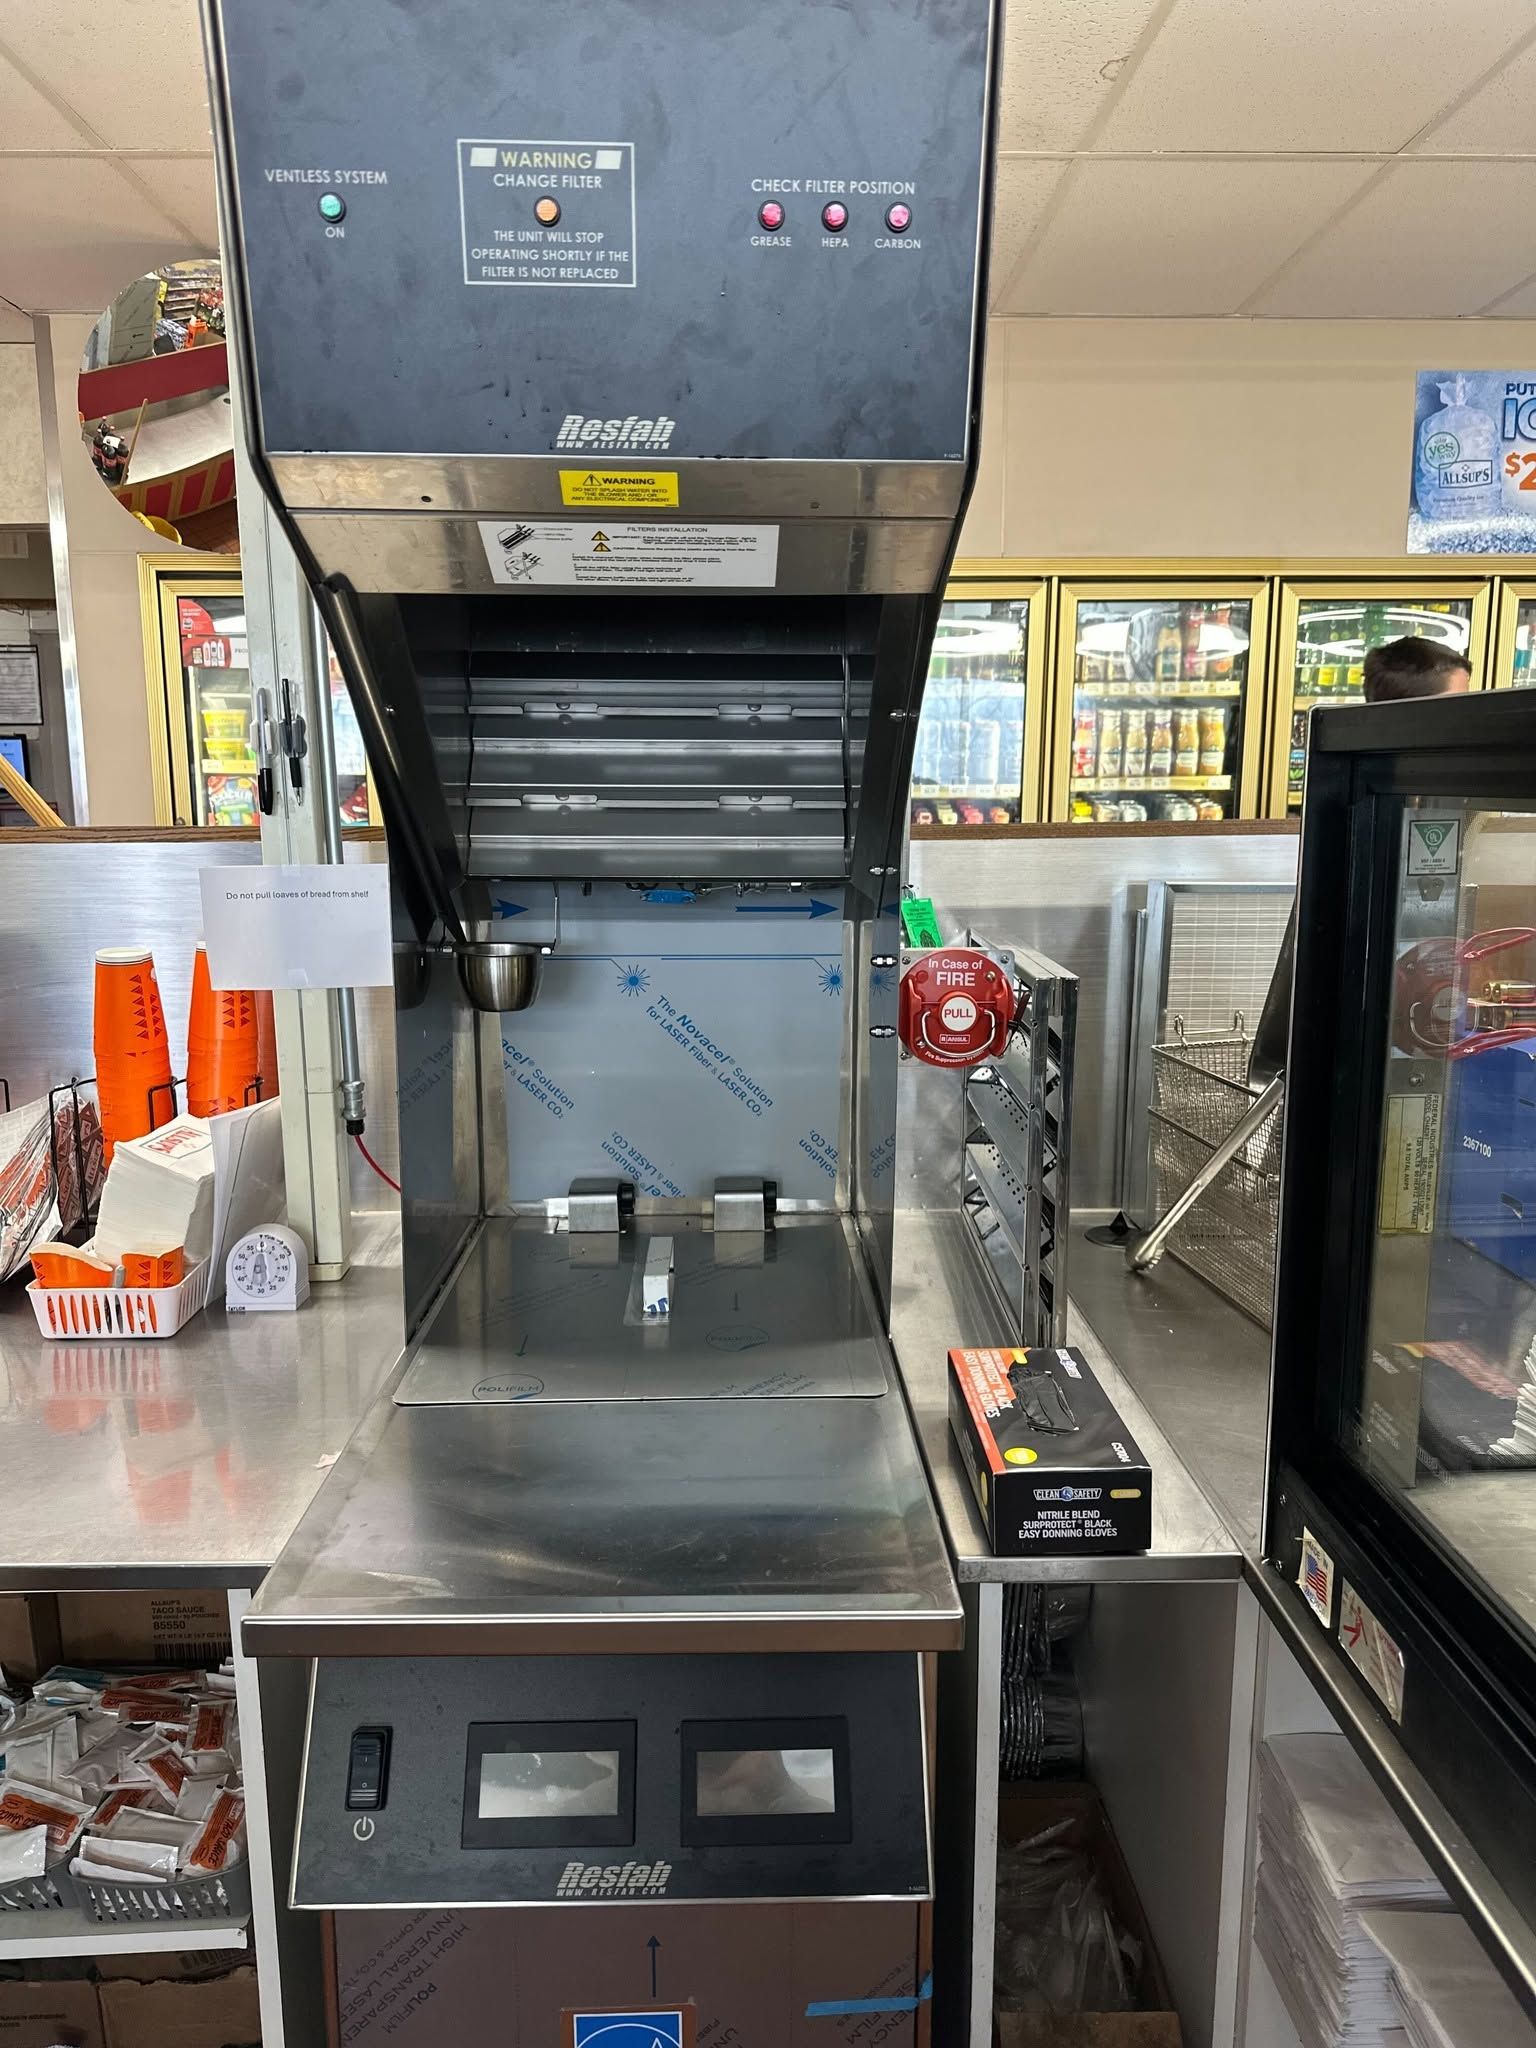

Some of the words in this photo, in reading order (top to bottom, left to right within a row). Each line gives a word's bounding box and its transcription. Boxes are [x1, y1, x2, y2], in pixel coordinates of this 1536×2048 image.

[500, 151, 592, 169] WARNING
[264, 169, 331, 184] VENTLESS
[335, 170, 388, 185] SYSTEM
[493, 173, 557, 188] CHANGE
[562, 174, 602, 189] FILTER
[751, 179, 801, 193] CHECK
[805, 180, 846, 194] FILTER
[850, 181, 916, 195] POSITION
[325, 227, 345, 238] ON
[493, 230, 515, 242] THE
[517, 230, 545, 243] UNIT
[547, 231, 573, 243] WILL
[575, 231, 604, 243] STOP
[750, 236, 792, 247] GREASE
[821, 237, 849, 248] HEPA
[874, 238, 921, 249] CARBON
[471, 248, 540, 261] OPERATING
[542, 249, 593, 262] SHORTLY
[595, 250, 605, 262] IF
[607, 250, 629, 262] THE
[482, 265, 516, 278] FILTER
[518, 266, 529, 278] IS
[531, 266, 557, 279] NOT
[559, 267, 619, 280] REPLACED
[556, 414, 677, 442] Resfab
[1428, 442, 1454, 460] yes
[602, 477, 655, 485] WARNING
[1442, 467, 1490, 485] ALLSUP'S
[226, 892, 239, 900] Do
[240, 892, 254, 900] not
[255, 892, 271, 901] pull
[273, 891, 299, 899] loaves
[350, 890, 369, 898] shelf
[928, 958, 939, 968] In
[941, 958, 969, 969] Case
[971, 959, 983, 969] of
[936, 971, 976, 987] FIRE
[944, 1008, 973, 1018] PULL
[646, 1005, 661, 1021] for
[660, 1018, 691, 1048] LASER
[688, 1045, 713, 1071] Fiber
[717, 1072, 748, 1101] LASER
[657, 994, 677, 1017] The
[732, 1067, 773, 1107] Solution
[517, 1073, 548, 1103] LASER
[532, 1068, 575, 1110] Solution
[1431, 1094, 1439, 1127] FEDERAL
[1427, 1128, 1436, 1169] INDUSTRIES
[1463, 1135, 1492, 1158] 2367100
[600, 1141, 642, 1181] Solution
[627, 1147, 658, 1176] LASER
[799, 1139, 838, 1178] Solution
[1414, 1148, 1422, 1168] VOLTS
[1410, 1204, 1418, 1225] PHASE
[1036, 1489, 1060, 1499] CLEAN
[1073, 1489, 1099, 1499] SAFETY
[1037, 1511, 1070, 1520] NITRILE
[1071, 1510, 1100, 1519] BLEND
[1084, 1519, 1112, 1528] BLACK
[1018, 1530, 1041, 1539] EASY
[1042, 1529, 1082, 1538] DONNING
[1084, 1528, 1118, 1537] GLOVES
[220, 1819, 235, 1838] TACO
[208, 1837, 226, 1867] SAUCE
[557, 1861, 673, 1888] Resfab
[431, 1923, 472, 1960] HIGH
[381, 1982, 438, 2034] POLIFILM
[846, 2011, 882, 2045] FILM
